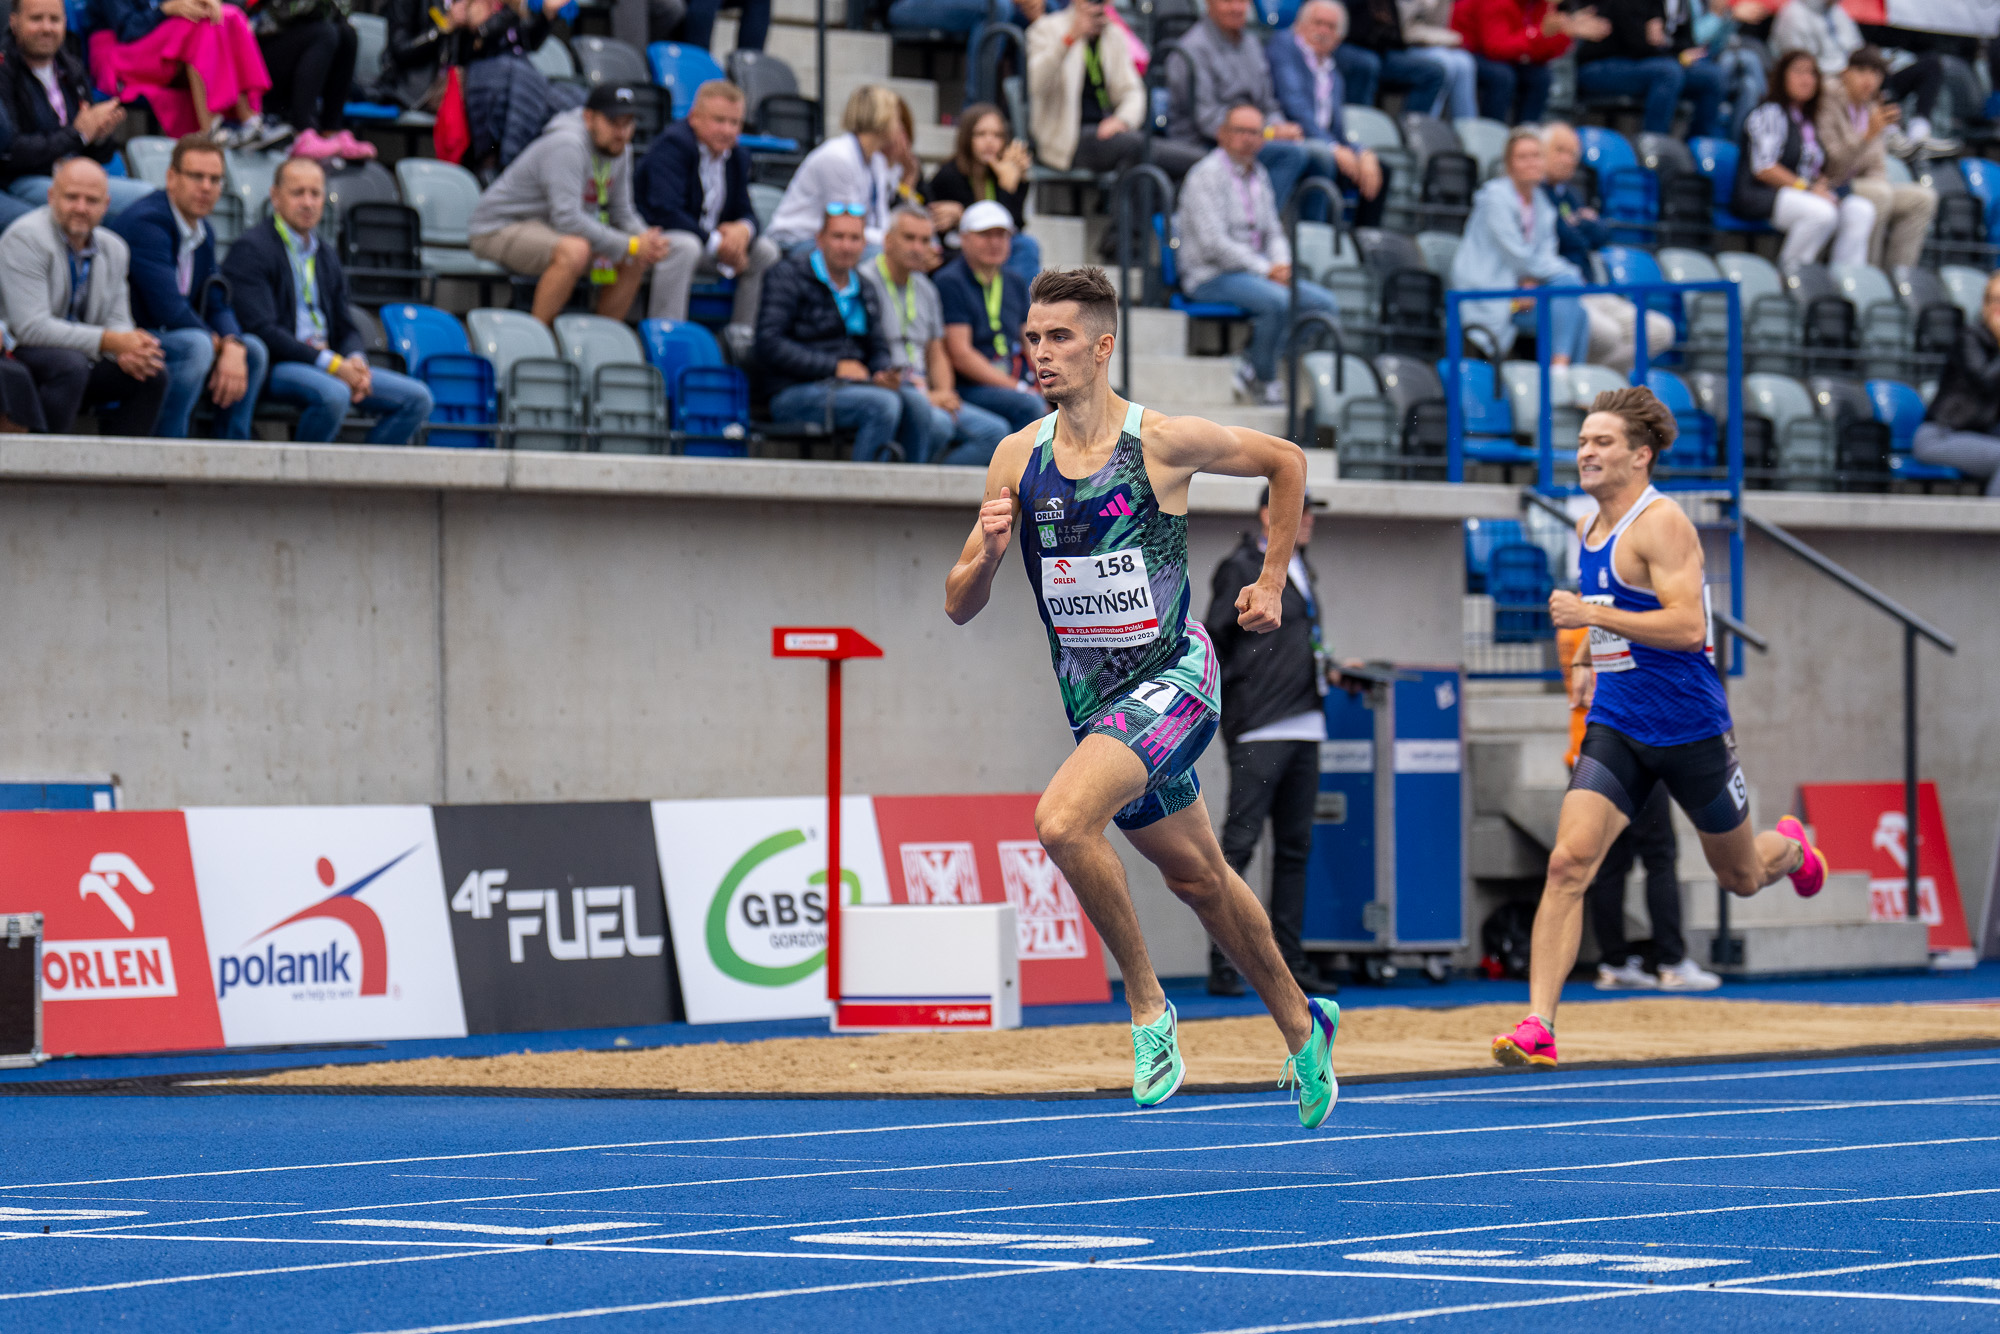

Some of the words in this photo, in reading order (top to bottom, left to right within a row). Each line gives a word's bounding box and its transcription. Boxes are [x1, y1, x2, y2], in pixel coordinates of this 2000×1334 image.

[1036, 511, 1062, 520] ORLEN
[1094, 554, 1135, 579] 158
[1047, 586, 1149, 616] DUSZYŃSKI
[1091, 634, 1137, 643] WIELKOPOLSKI
[1137, 631, 1155, 640] 2023
[1125, 622, 1144, 633] Polski
[1140, 680, 1171, 702] 7
[1734, 774, 1746, 800] 8
[451, 868, 508, 919] 4F
[506, 884, 664, 963] FUEL
[742, 891, 827, 928] GBS
[42, 949, 166, 990] ORLEN
[219, 940, 351, 998] polanik
